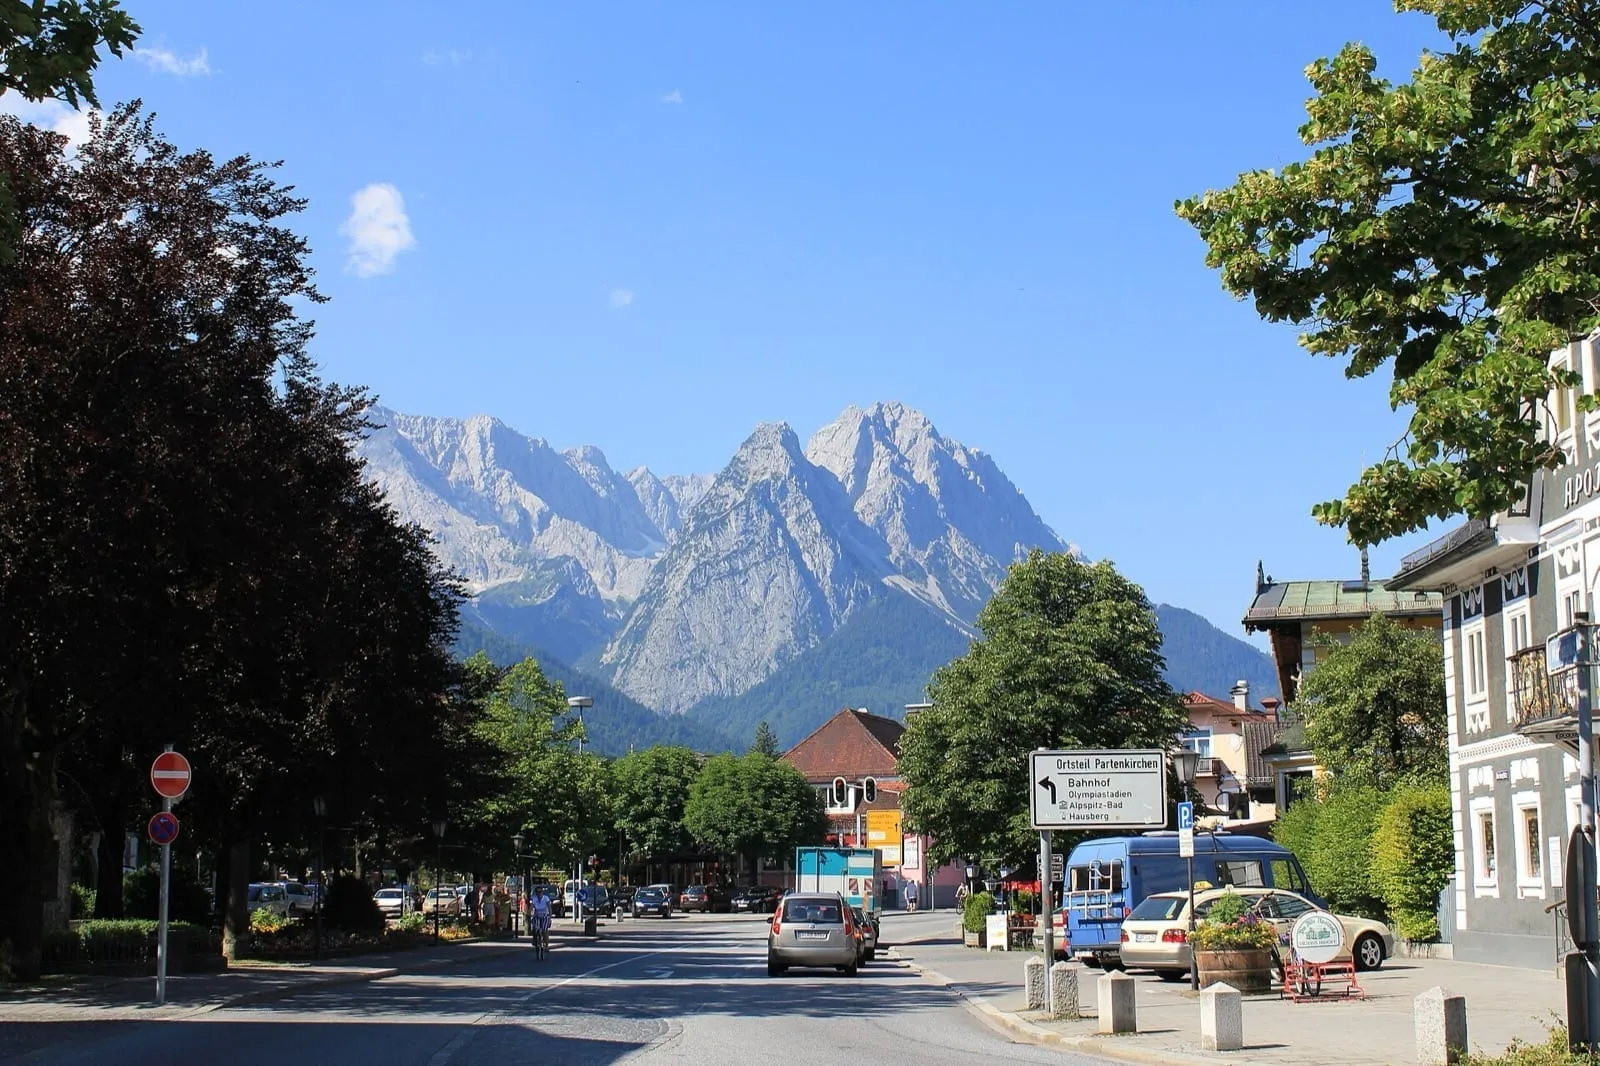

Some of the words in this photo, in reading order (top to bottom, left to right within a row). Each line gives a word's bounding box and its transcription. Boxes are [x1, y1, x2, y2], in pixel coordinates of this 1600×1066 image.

[1057, 759, 1090, 770] Ortsteil
[1095, 758, 1158, 769] Partenkirchen
[1068, 778, 1110, 788] Bahnhof
[1068, 791, 1132, 799] Olympiastadien
[1069, 801, 1123, 810] Alpspitz-Bad
[1069, 812, 1109, 821] Hausberg
[1181, 806, 1189, 828] P
